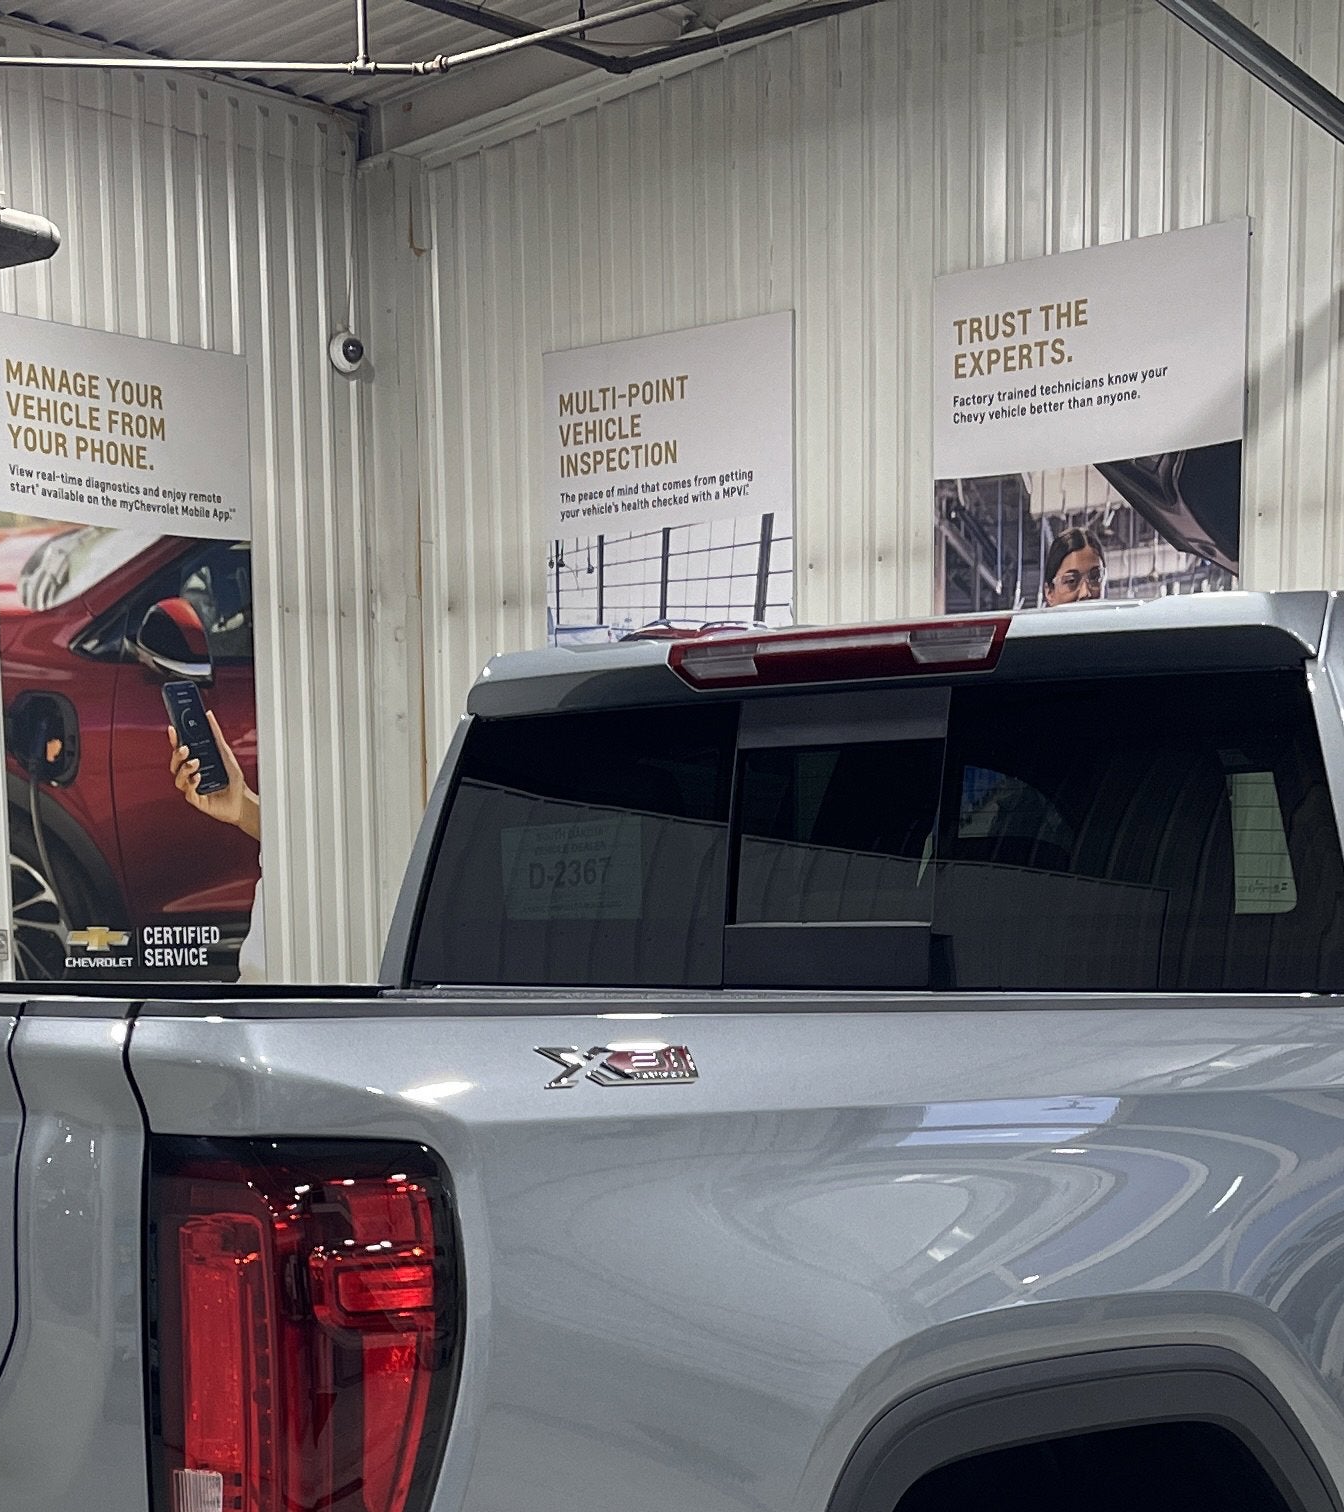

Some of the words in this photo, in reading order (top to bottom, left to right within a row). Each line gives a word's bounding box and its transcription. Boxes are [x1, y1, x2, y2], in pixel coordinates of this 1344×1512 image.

[953, 308, 1032, 345] TRUST
[1040, 299, 1088, 332] THE
[954, 338, 1073, 379] EXPERTS.
[5, 358, 100, 400] MANAGE
[106, 377, 163, 410] YOUR
[559, 375, 688, 417] MULTI-POINT
[953, 391, 994, 408] Factory
[997, 385, 1037, 401] trained
[1040, 376, 1104, 396] technicians
[1107, 370, 1138, 386] know
[1141, 366, 1168, 383] your
[6, 390, 101, 432] VEHICLE
[108, 409, 166, 441] FROM
[953, 410, 986, 425] Chevy
[989, 405, 1027, 421] vehicle
[1029, 400, 1064, 415] better
[1068, 395, 1093, 409] than
[1096, 389, 1141, 407] anyone.
[7, 423, 68, 458] YOUR
[76, 435, 155, 471] PHONE.
[559, 413, 642, 447] VEHICLE
[560, 439, 678, 478] INSPECTION
[9, 463, 33, 478] View
[36, 469, 83, 487] real-time
[85, 475, 141, 496] diagnostics
[142, 484, 160, 497] and
[162, 488, 187, 504] enjoy
[188, 492, 222, 504] remote
[560, 492, 576, 504] The
[578, 491, 604, 504] peace
[606, 486, 616, 498] of
[617, 483, 639, 497] mind
[641, 481, 660, 494] that
[662, 478, 692, 491] comes
[693, 475, 717, 487] from
[719, 469, 753, 486] getting
[41, 486, 85, 503] available
[87, 495, 99, 505] on
[101, 495, 117, 508] the
[119, 499, 179, 516] myChevrolet
[181, 505, 211, 519] Mobile
[560, 509, 579, 522] your
[621, 499, 650, 513] health
[651, 495, 689, 509] checked
[691, 491, 712, 503] with
[714, 492, 720, 501] a
[528, 856, 613, 890] D-2367
[143, 926, 220, 945] CERTIFIED
[65, 957, 133, 968] CHEVROLET
[144, 948, 208, 967] SERVICE
